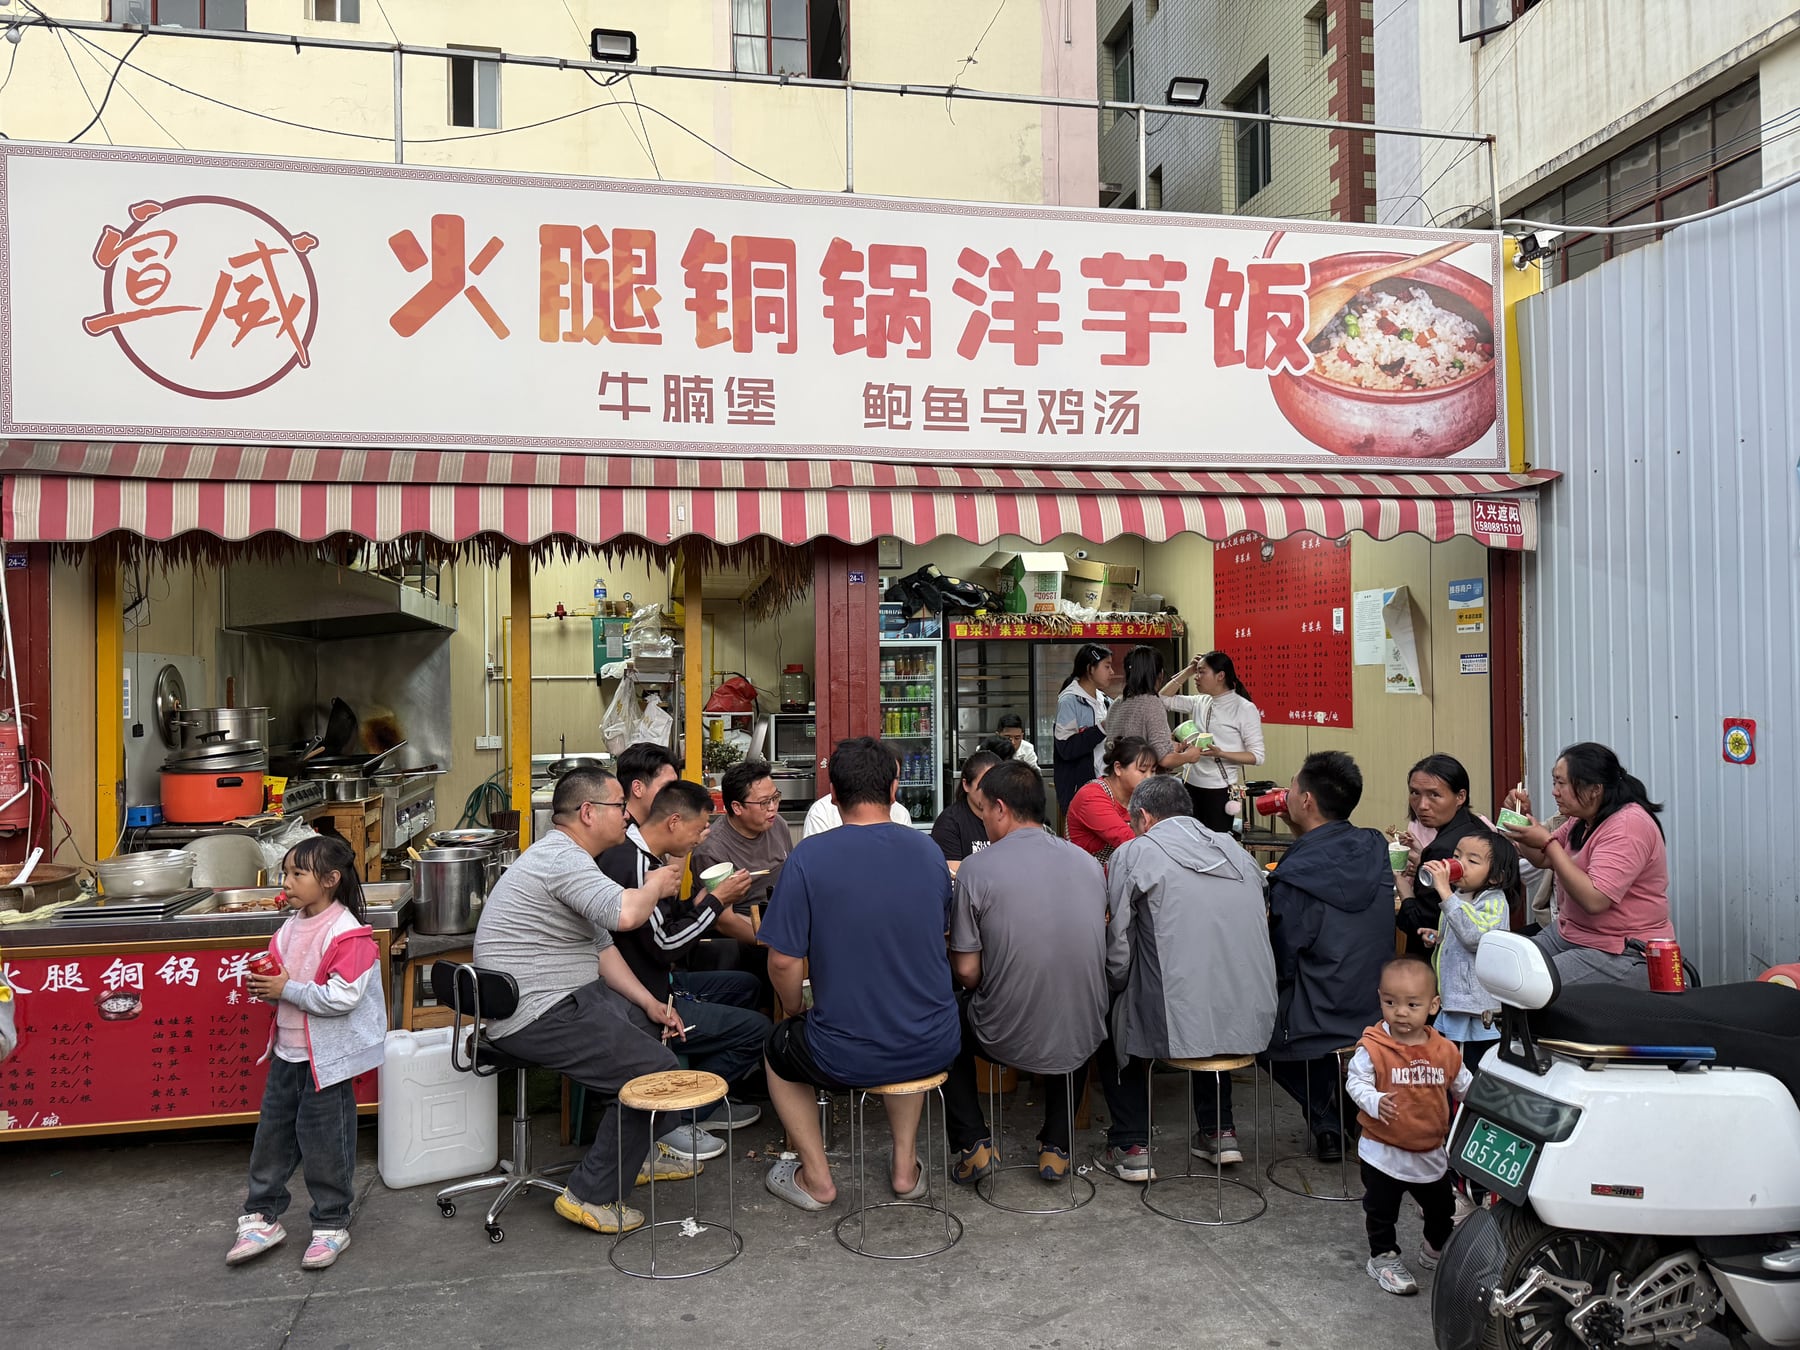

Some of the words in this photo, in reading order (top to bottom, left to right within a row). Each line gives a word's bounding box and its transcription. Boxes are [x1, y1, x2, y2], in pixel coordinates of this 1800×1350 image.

[82, 199, 319, 369] 宣威
[388, 213, 1312, 372] 火腿铜锅洋芋饭
[598, 370, 777, 426] 牛腩堡
[862, 381, 1141, 436] 鲍鱼乌鸡汤
[1475, 502, 1520, 522] 久兴遮阳
[1475, 520, 1522, 534] 15808815110
[8, 558, 27, 567] 24-2
[849, 574, 864, 582] 24-1
[1671, 950, 1682, 987] 王老吉
[52, 1021, 94, 1032] 4元/串
[152, 1016, 195, 1026] 娃娃菜
[152, 1029, 194, 1040] 油豆腐
[51, 1035, 94, 1046] 3元/个
[151, 1045, 193, 1056] 四季豆
[50, 1065, 94, 1075] 2元/个
[50, 1078, 93, 1089] 2元/串
[49, 1094, 93, 1105] 2元/根
[1466, 1140, 1521, 1181] Q576B
